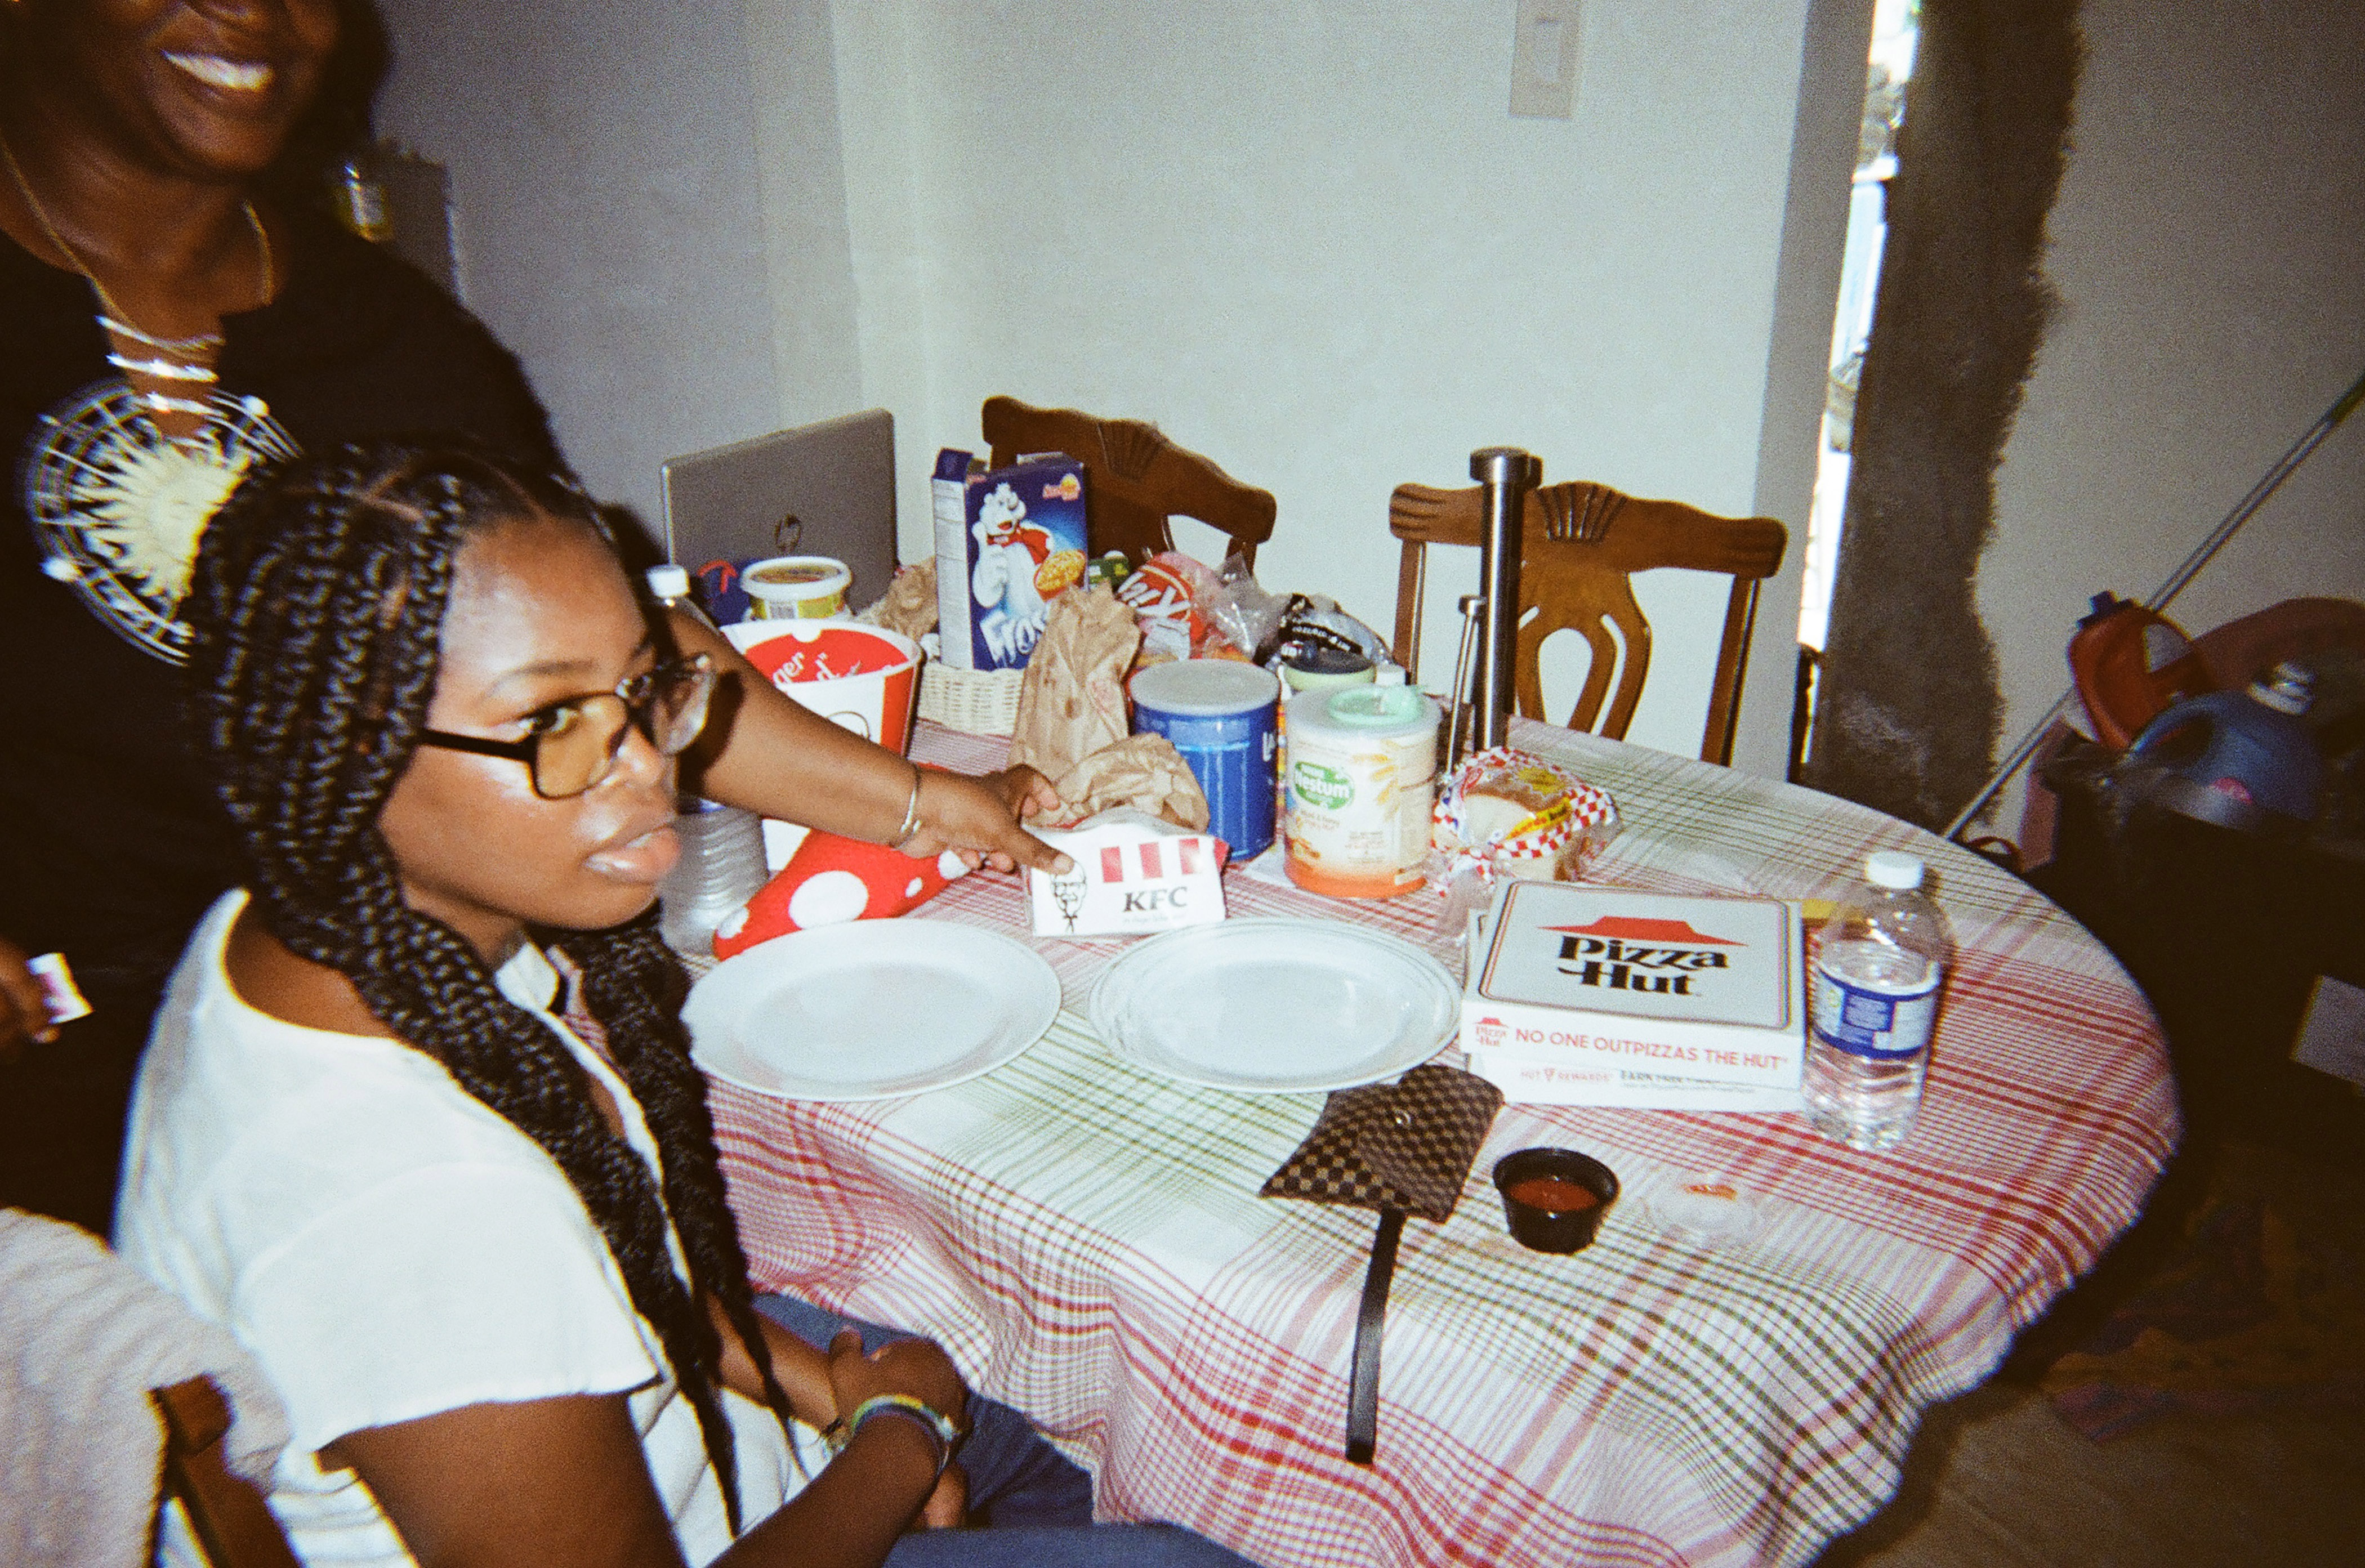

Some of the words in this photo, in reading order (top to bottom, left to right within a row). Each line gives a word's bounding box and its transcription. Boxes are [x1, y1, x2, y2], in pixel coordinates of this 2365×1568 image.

[1295, 769, 1350, 799] Nestum
[1122, 886, 1188, 913] KFC
[1558, 935, 1730, 971] Pizza
[1557, 960, 1697, 995] Hut
[1515, 1028, 1545, 1043] NO
[1550, 1031, 1588, 1048] ONE
[1594, 1037, 1698, 1062] OUTPIZZAS
[1704, 1048, 1738, 1066] THE
[1743, 1054, 1781, 1070] HUT
[1619, 1070, 1653, 1082] EARN
